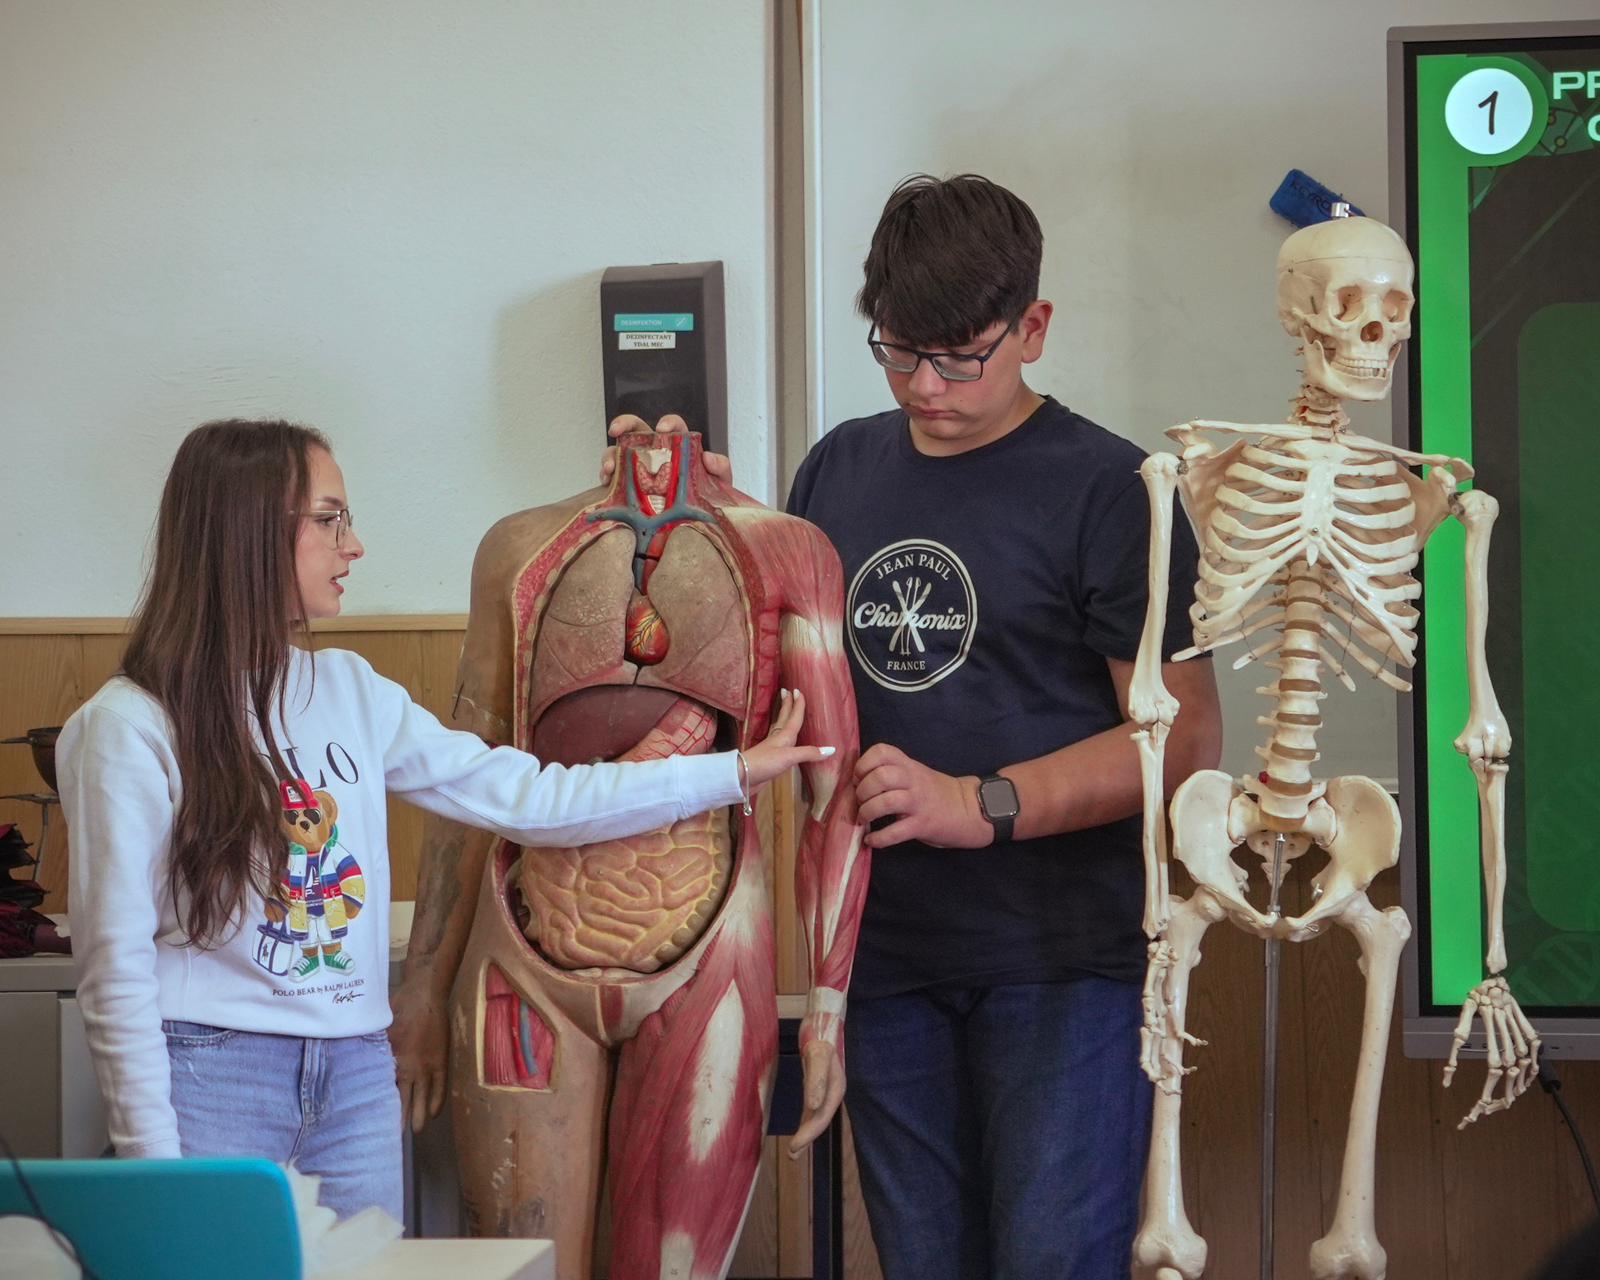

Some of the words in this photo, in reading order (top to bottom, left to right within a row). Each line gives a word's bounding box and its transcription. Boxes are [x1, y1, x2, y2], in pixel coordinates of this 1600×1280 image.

[1478, 90, 1498, 135] 1
[875, 553, 914, 580] JEAN
[918, 553, 952, 580] PAUL
[886, 660, 926, 671] FRANCE
[272, 988, 295, 997] POLO
[296, 986, 316, 996] BEAR
[317, 987, 324, 995] by
[324, 982, 343, 993] RALPH
[344, 978, 365, 990] LAUREN
